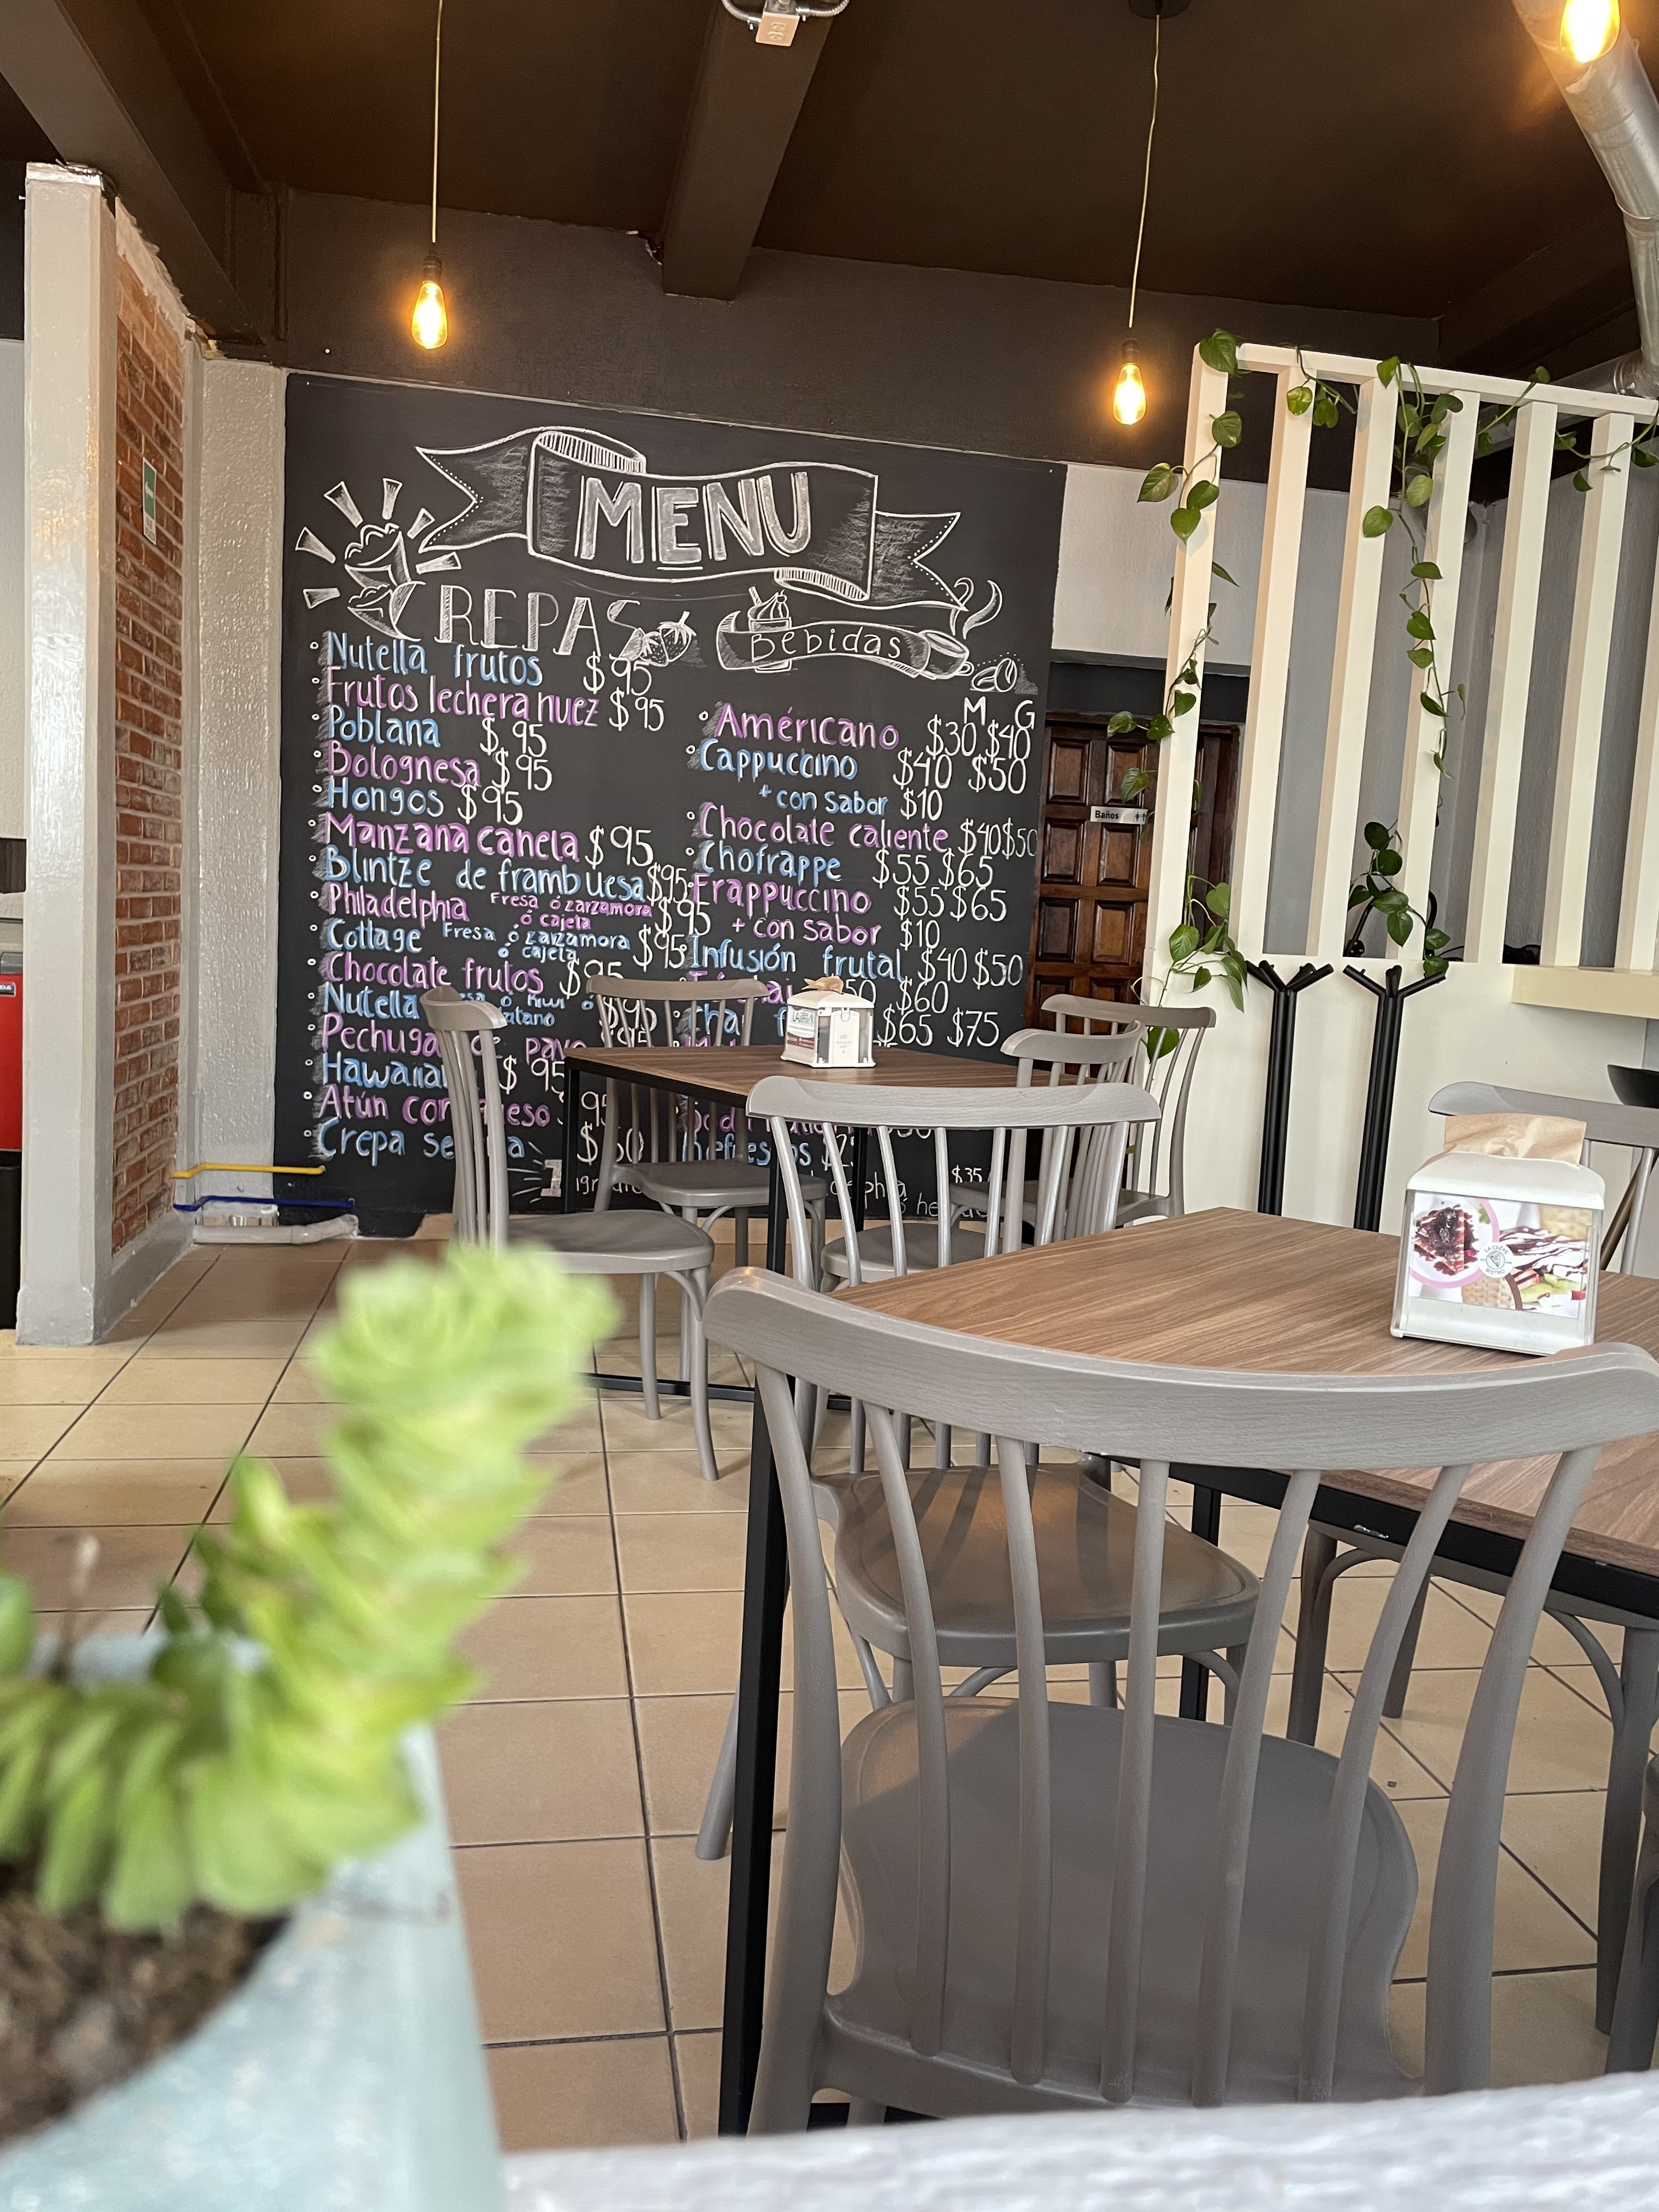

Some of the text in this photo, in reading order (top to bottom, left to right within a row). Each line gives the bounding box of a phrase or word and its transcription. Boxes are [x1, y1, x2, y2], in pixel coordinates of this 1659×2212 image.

[575, 472, 811, 568] MENU
[329, 632, 427, 675] Nutella
[454, 644, 543, 686] frutos
[329, 665, 419, 712] Frutos
[430, 675, 530, 721] lechera
[538, 692, 600, 727] nuez
[964, 696, 1035, 729] M G
[329, 704, 441, 747] Poblana
[926, 714, 977, 760] $30
[985, 719, 1031, 763] $40
[329, 740, 482, 788] Bolognesa
[701, 738, 1026, 794] Cappuccino $40 $50
[329, 775, 444, 817] Hongos
[776, 790, 817, 810] con
[825, 791, 889, 816] sabor
[901, 788, 943, 821] $10
[1095, 810, 1119, 820] Baños
[324, 811, 470, 854] Manzana
[477, 826, 579, 862] canela
[699, 802, 834, 846] Chocolate
[849, 819, 949, 853] caliente
[958, 818, 1001, 855] $40
[325, 844, 432, 888] Blintze
[455, 858, 487, 890] de
[647, 862, 688, 906] $95
[701, 840, 993, 890] Chofrappe $55 $65
[329, 882, 470, 929] Philadelphia
[491, 892, 539, 909] Fresa
[565, 900, 653, 918] zarzamora
[692, 873, 1007, 922] Frappuccino $55 $65
[443, 922, 496, 941] Fresa
[539, 913, 592, 931] cajeta
[753, 917, 794, 939] con
[803, 913, 882, 945] sabor
[900, 918, 940, 951] $10
[326, 951, 452, 989] Chocolate
[461, 957, 544, 995] frutos
[690, 935, 1023, 990] Infusión frutal $40 $50
[323, 981, 420, 1019] Nutella
[896, 976, 949, 1014] $60
[323, 1012, 442, 1058] Pechuga
[877, 1003, 933, 1047] $65
[947, 1007, 1000, 1047] $75
[318, 1084, 389, 1120] Atún
[318, 1116, 406, 1166] Crepa
